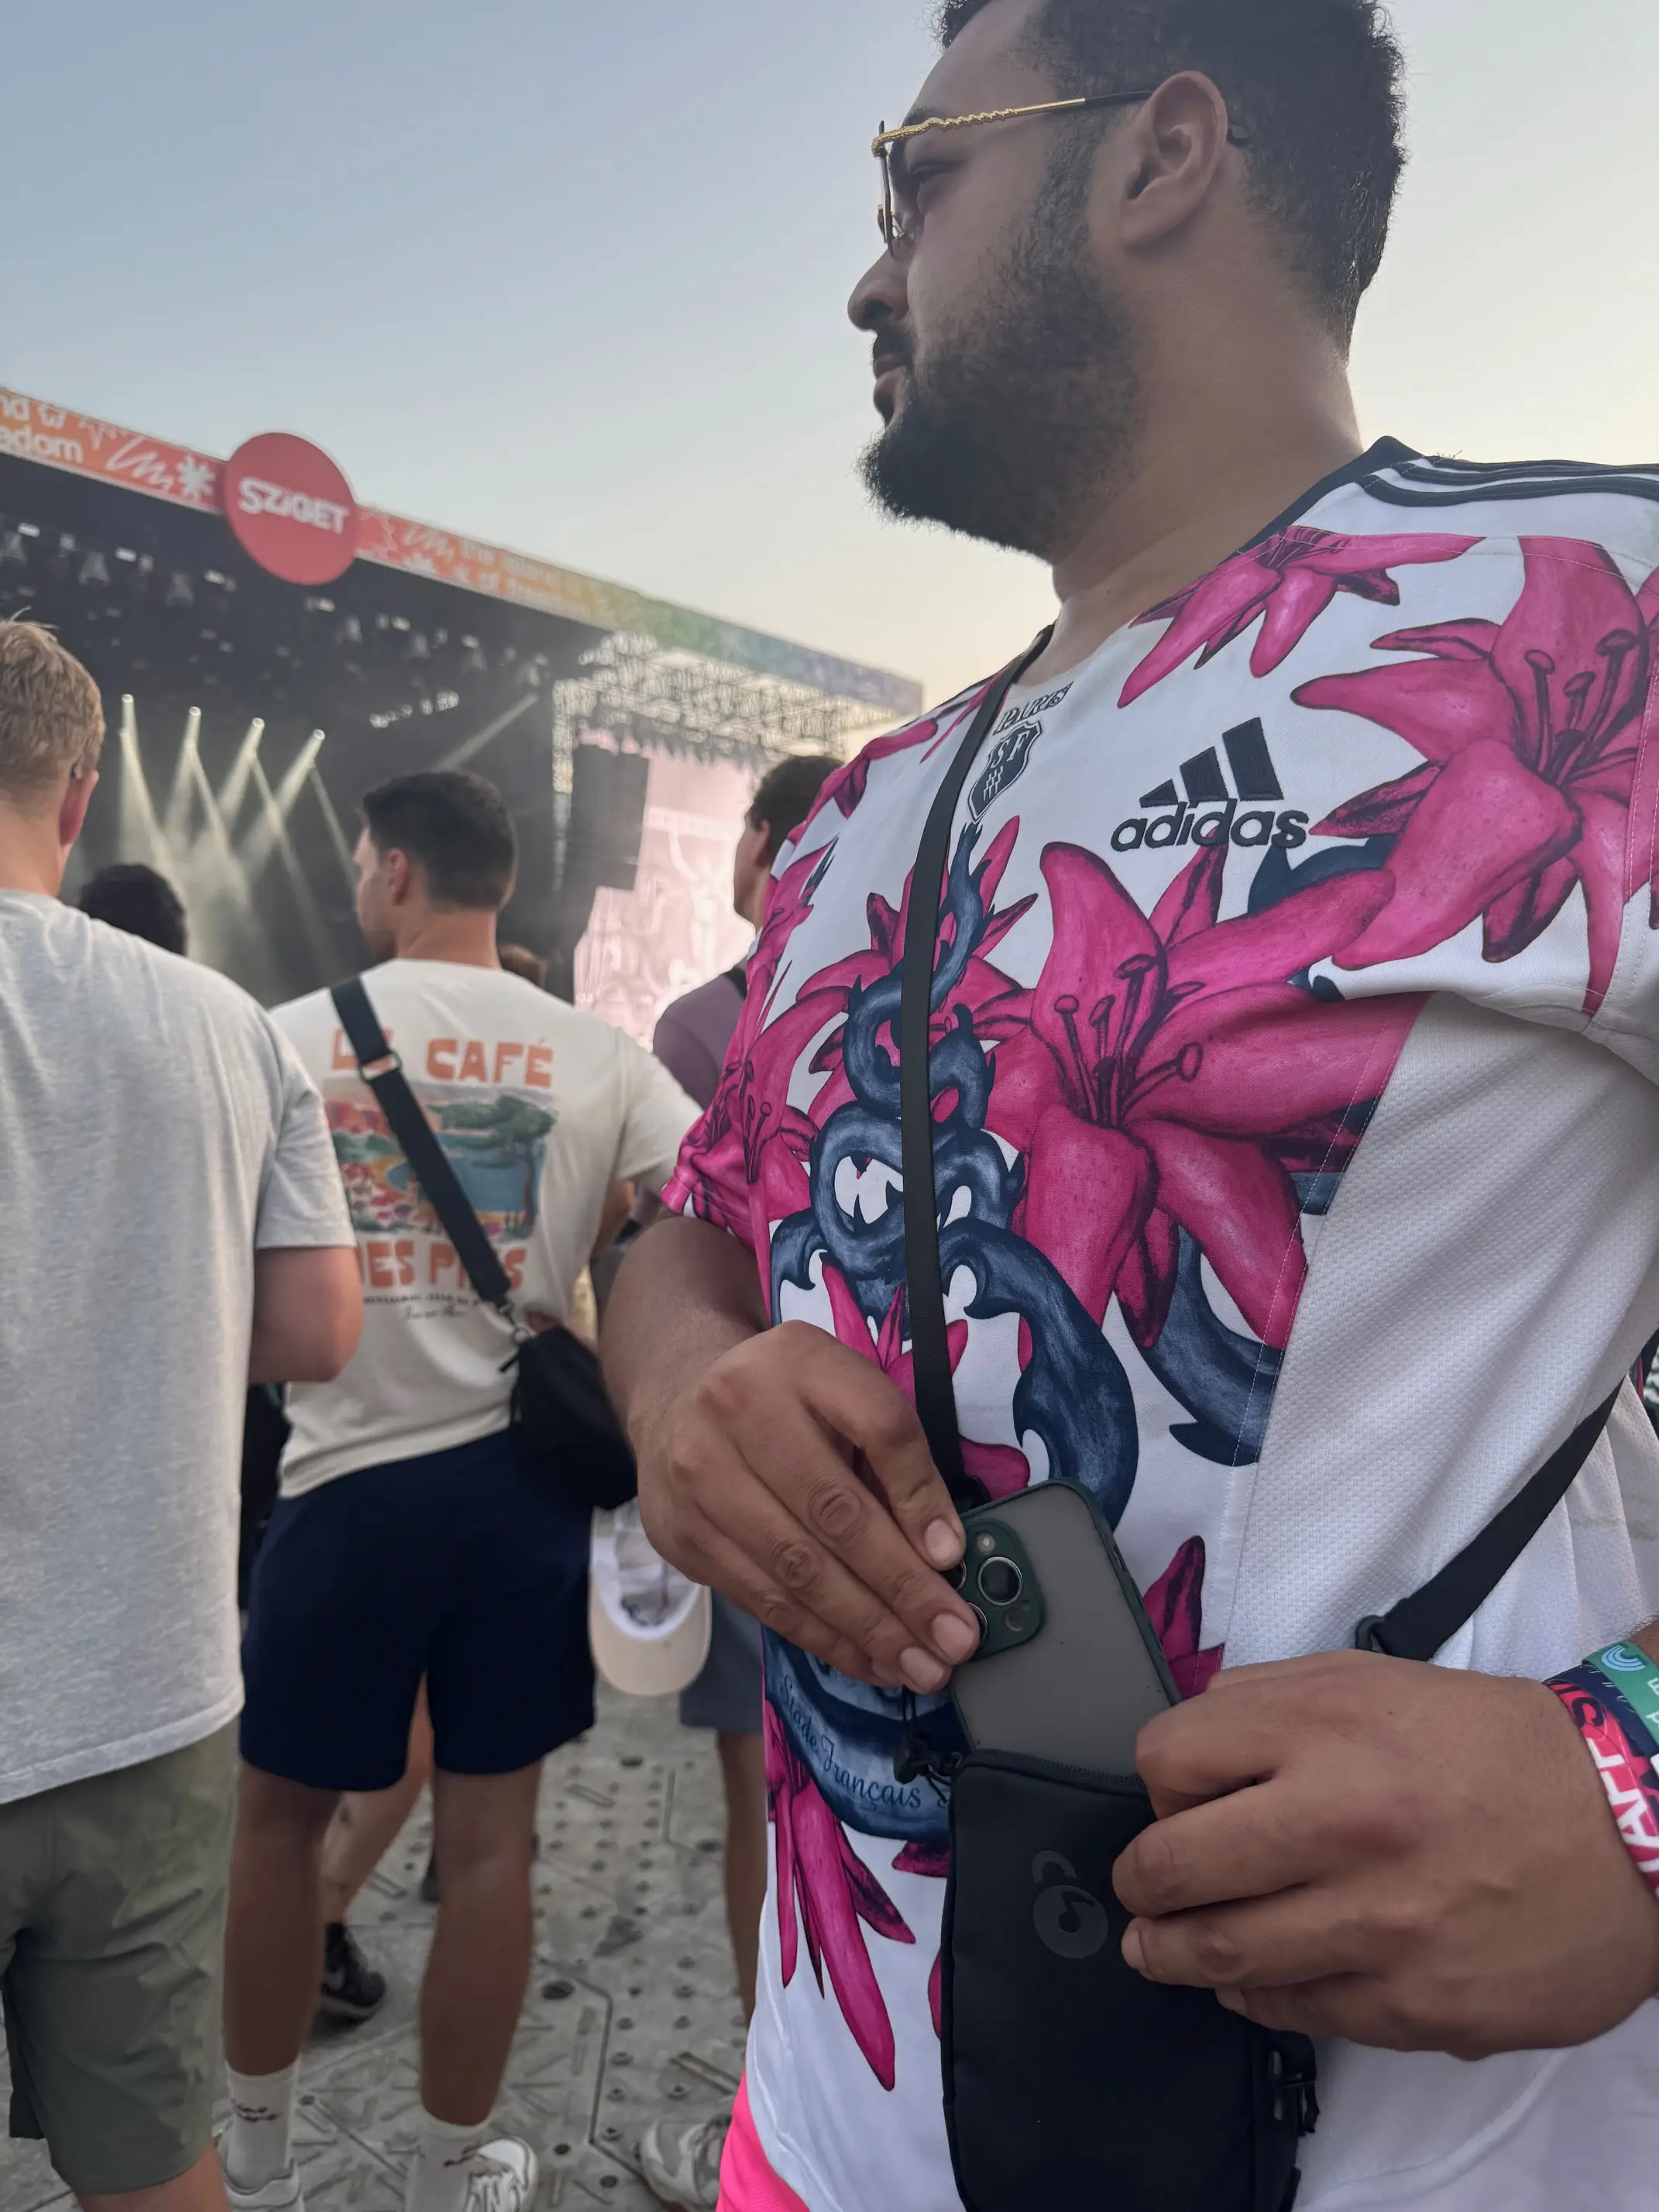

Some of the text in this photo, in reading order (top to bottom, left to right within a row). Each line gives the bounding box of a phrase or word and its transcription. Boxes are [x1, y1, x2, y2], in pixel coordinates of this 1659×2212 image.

[1110, 799, 1310, 852] adidas
[426, 1038, 555, 1089] CAFÉ
[357, 1240, 528, 1292] ES PS
[779, 1674, 818, 1753] Stade
[1586, 1736, 1659, 1900] AFF
